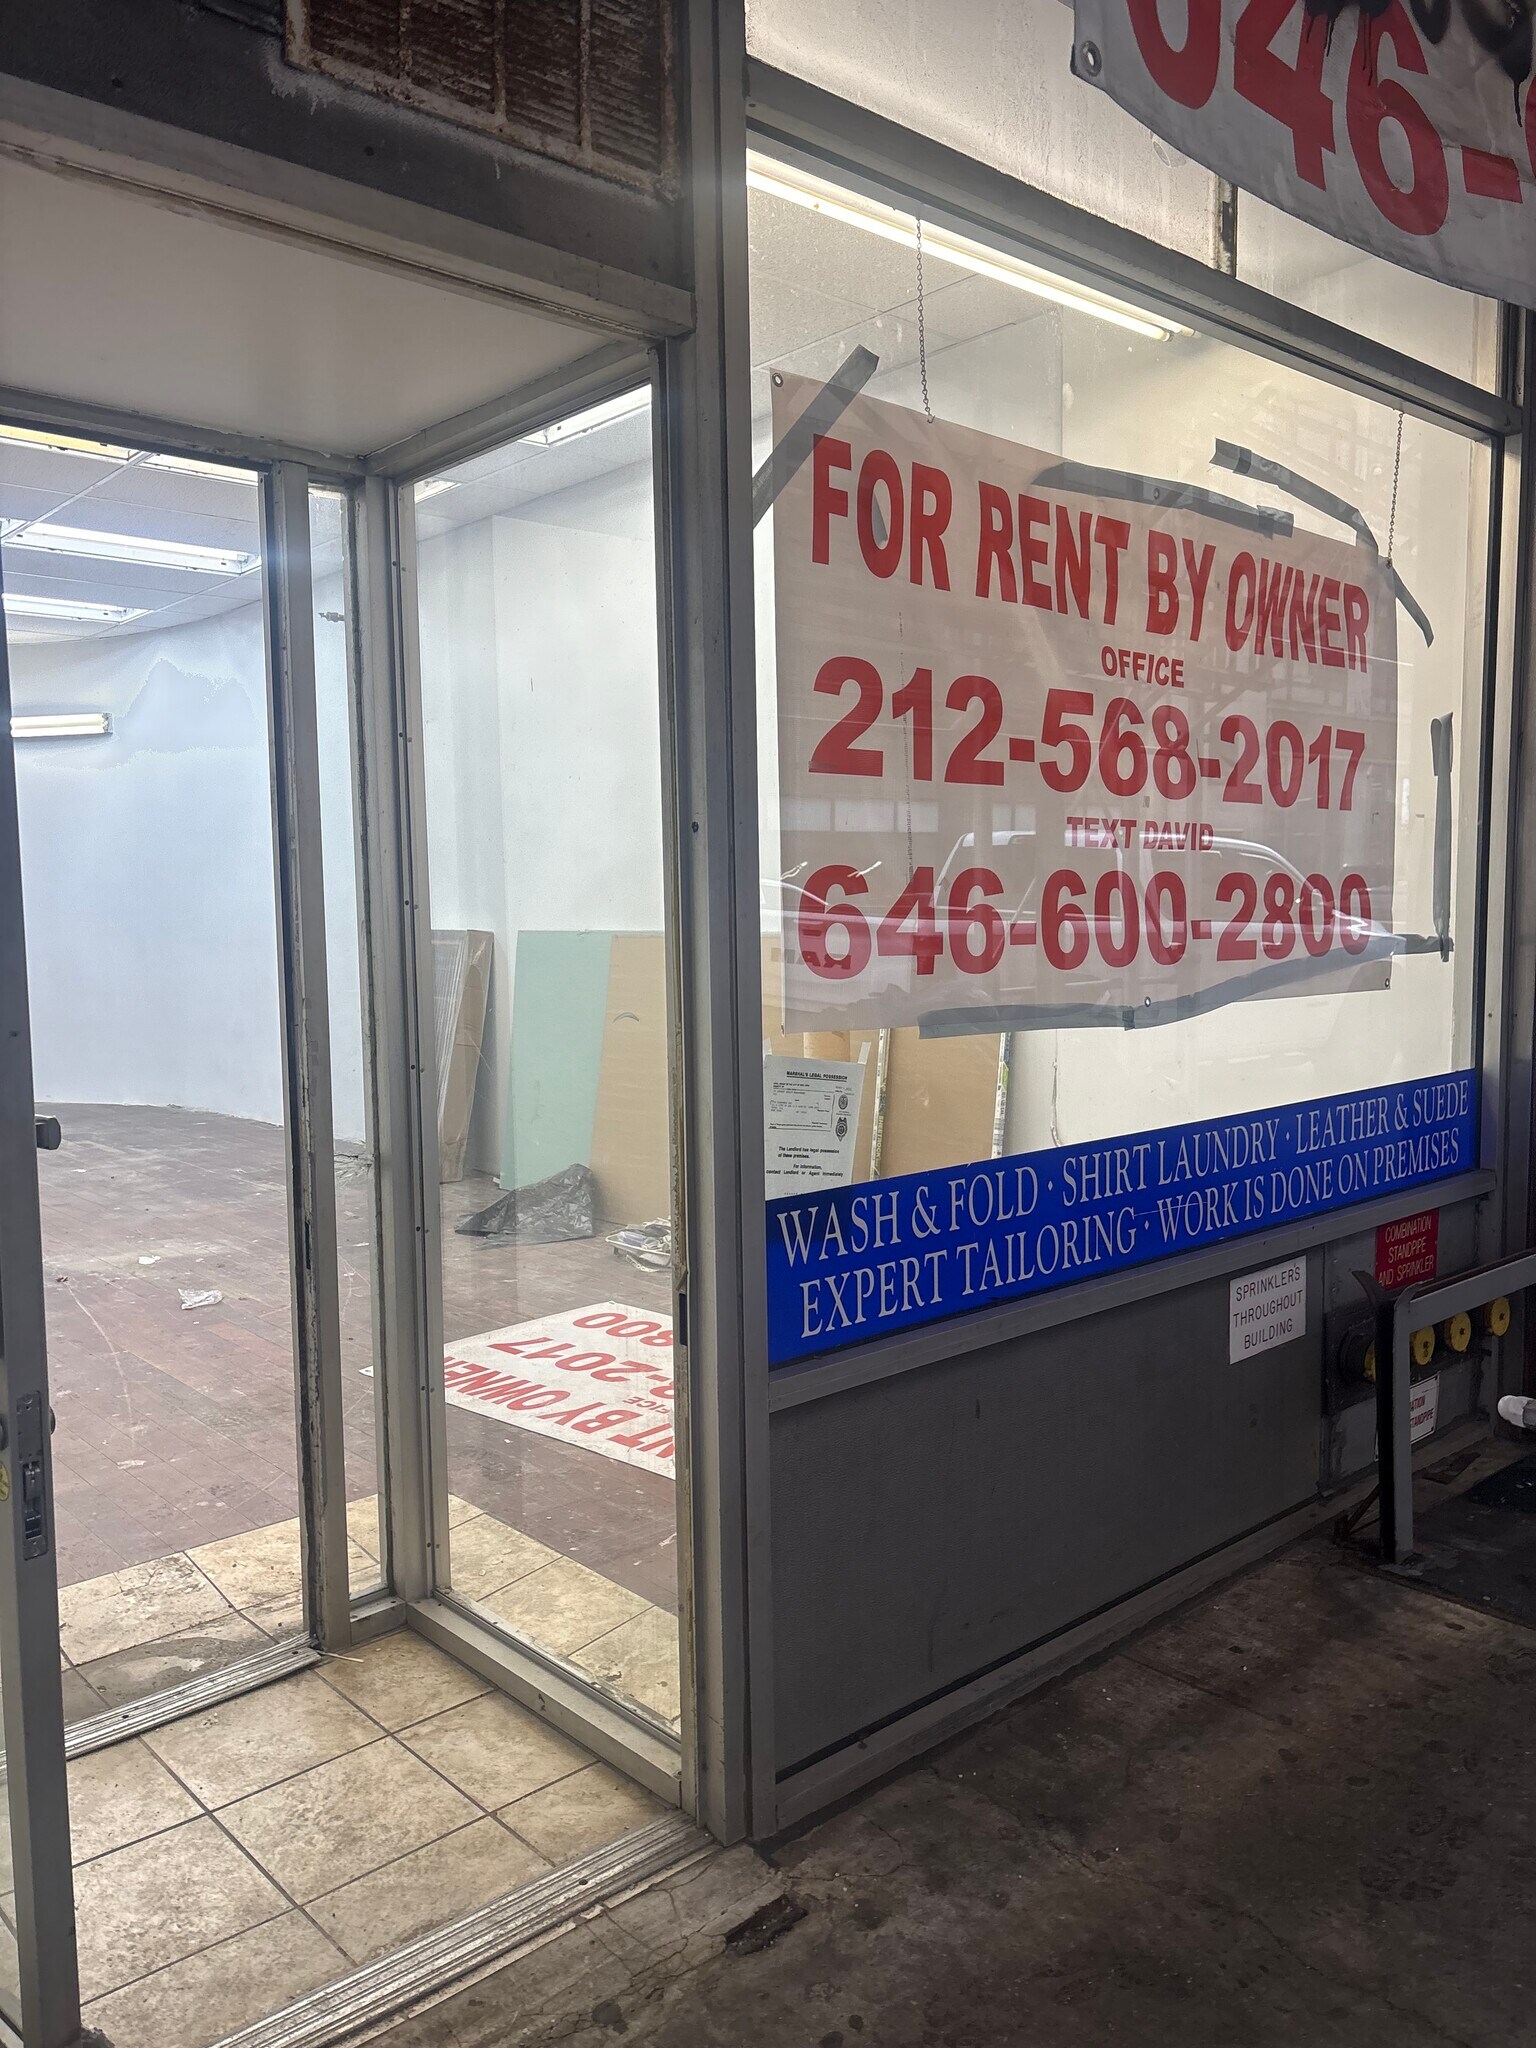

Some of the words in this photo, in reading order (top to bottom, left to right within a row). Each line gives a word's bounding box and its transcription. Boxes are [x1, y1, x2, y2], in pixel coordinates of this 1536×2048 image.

[811, 433, 952, 592] FOR
[975, 480, 1131, 626] RENT
[1146, 529, 1217, 642] BY
[1225, 551, 1370, 673] OWNER
[1101, 645, 1185, 688] OFFICE
[808, 656, 1366, 811] 212-568-2017
[1066, 816, 1138, 849] TEXT
[1143, 820, 1214, 852] DAVID
[798, 864, 1372, 980] 646-600-2800
[777, 1190, 902, 1268] WASH
[911, 1185, 942, 1239] &
[948, 1165, 1039, 1232] FOLD
[1062, 1143, 1152, 1207] SHIRT
[1157, 1118, 1281, 1187] LAUNDRY
[1296, 1095, 1391, 1155] LEATHER
[1394, 1092, 1410, 1130] &
[1412, 1079, 1470, 1127] SUEDE
[799, 1249, 948, 1339] EXPERT
[956, 1206, 1137, 1296] TAILORING
[1156, 1180, 1240, 1244] WORK
[1244, 1175, 1265, 1221] IS
[1270, 1159, 1334, 1214] DONE
[1337, 1149, 1369, 1196] ON
[1373, 1126, 1460, 1186] PREMISES
[1384, 1214, 1432, 1243] COMBINATION
[1388, 1236, 1427, 1264] STANDPIPE
[1379, 1268, 1394, 1287] AND
[1396, 1254, 1435, 1281] SPRINKLER
[1233, 1289, 1304, 1328] THROUGHOUT
[1244, 1318, 1293, 1350] BUILDING
[536, 1401, 644, 1434] BY
